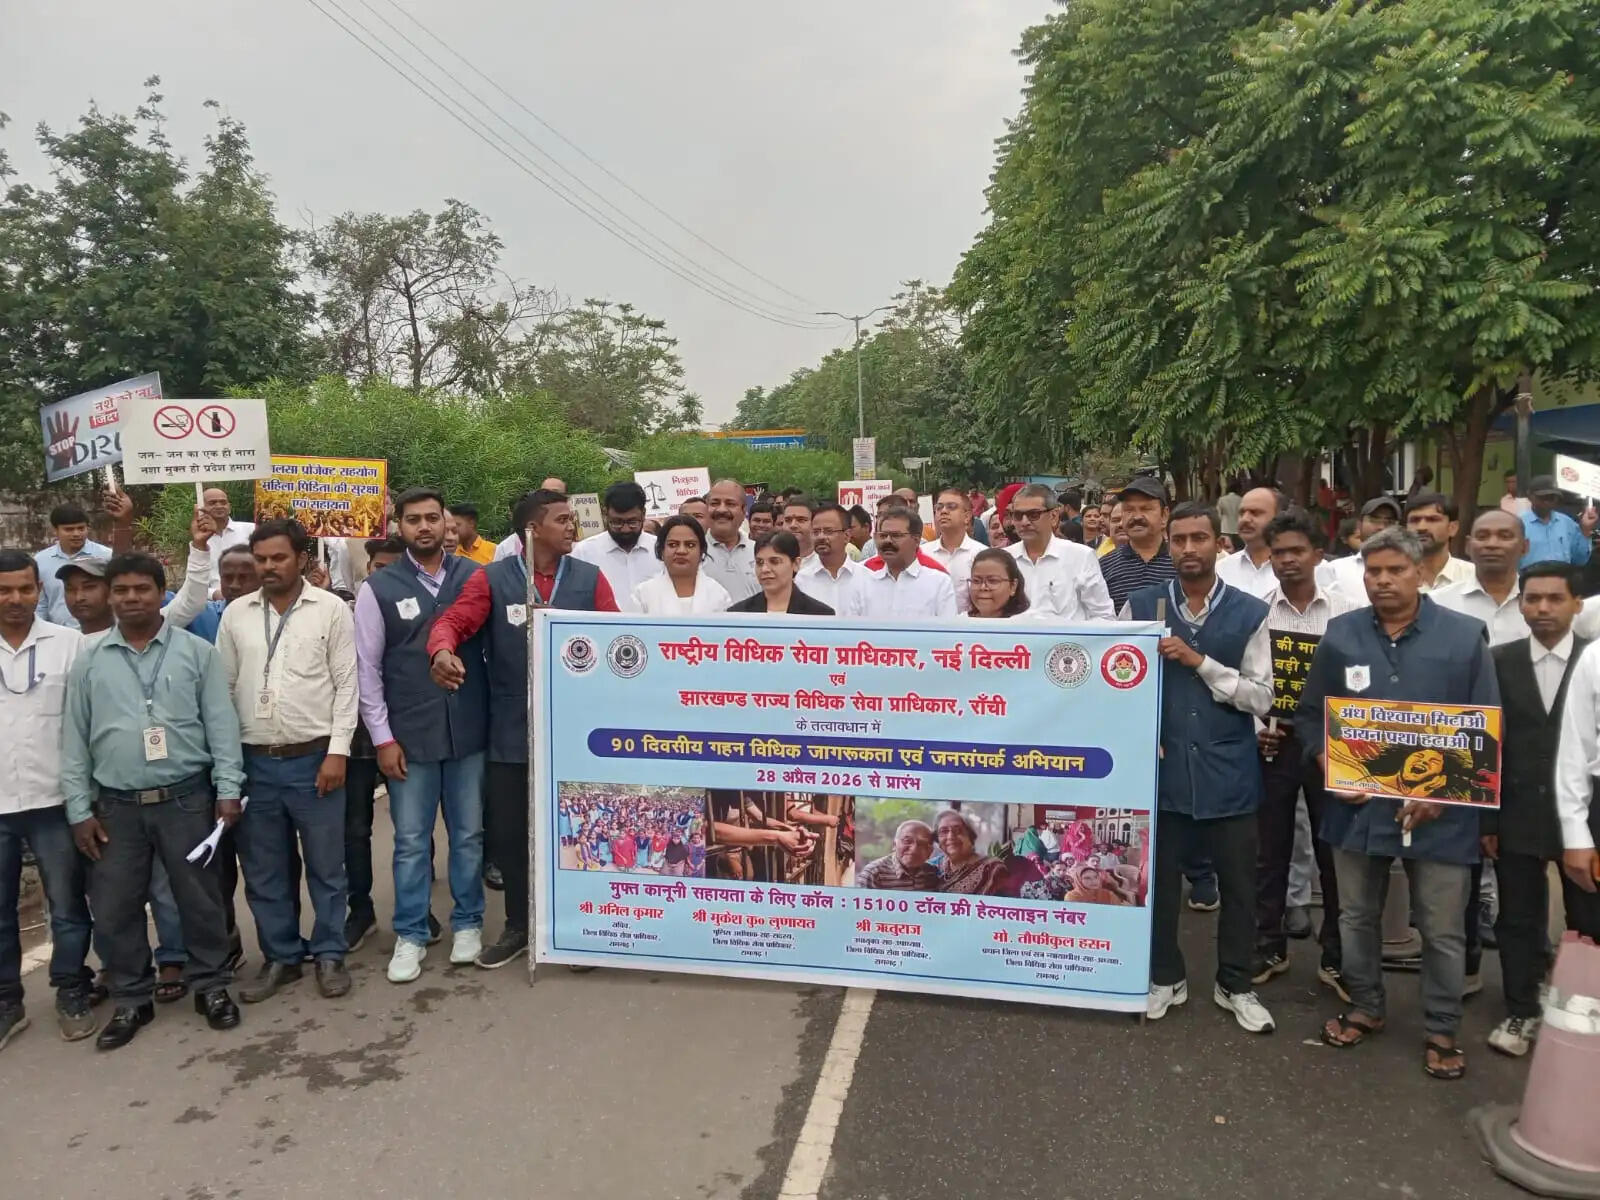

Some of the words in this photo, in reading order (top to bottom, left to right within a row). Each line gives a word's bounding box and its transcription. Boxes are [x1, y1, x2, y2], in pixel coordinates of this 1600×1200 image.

[49, 436, 75, 456] STOP
[166, 450, 182, 459] जन
[187, 450, 199, 458] का
[202, 450, 218, 459] एक
[235, 449, 256, 457] नारा
[141, 466, 161, 474] नशा
[164, 465, 186, 476] मुक्त
[203, 462, 226, 472] प्रदेश
[229, 463, 255, 472] हमारा
[272, 464, 298, 474] ालसा
[339, 466, 377, 477] सहयोग
[262, 479, 294, 491] महिला
[334, 482, 347, 493] की
[351, 485, 379, 496] सुरक्षा
[292, 497, 307, 509] एवं
[310, 500, 350, 510] सहायता
[659, 637, 718, 665] राष्ट्रीय
[725, 638, 784, 664] विधिक
[790, 640, 829, 665] सेवा
[835, 640, 925, 670] प्राधिकार,
[932, 643, 962, 671] नई
[969, 644, 1031, 670] दिल्ली
[1276, 636, 1294, 652] की
[1297, 642, 1319, 655] मा
[829, 671, 846, 686] एवं
[679, 690, 747, 708] झारखण्ड
[752, 691, 789, 709] राज्य
[796, 690, 844, 711] विधिक
[852, 691, 882, 711] सेवा
[888, 692, 963, 717] प्राधिकार,
[969, 692, 1007, 716] राँची
[795, 716, 807, 731] के
[810, 718, 868, 733] तत्वावधान
[870, 719, 881, 733] में
[1340, 704, 1366, 720] अंध
[1370, 706, 1427, 725] विश्वास
[1430, 710, 1487, 729] मिटाओ
[1341, 726, 1383, 742] डायन
[1384, 729, 1418, 745] प्रथा
[1419, 732, 1470, 749] हटाओ
[611, 737, 635, 753] 90
[642, 734, 703, 756] दिवसीय
[709, 739, 744, 757] गहन
[750, 737, 801, 760] विधिक
[807, 743, 893, 764] जागरूकता
[899, 746, 924, 767] एवं
[929, 747, 1006, 769] जनसंपर्क
[1012, 752, 1085, 773] अभियान
[756, 769, 776, 783] 28
[782, 766, 816, 785] अप्रैल
[821, 772, 862, 788] 2026
[868, 771, 881, 789] से
[886, 773, 922, 792] प्रारंभ
[579, 902, 593, 914] श्री
[598, 903, 629, 917] अनिल
[633, 905, 664, 920] कुमार
[609, 881, 639, 900] मुफ्त
[643, 882, 688, 902] कानूनी
[692, 886, 745, 903] सहायता
[750, 886, 765, 904] के
[768, 887, 796, 909] लिए
[801, 890, 834, 910] कॉल
[852, 896, 908, 914] 15100
[914, 897, 946, 915] टॉल
[949, 899, 971, 918] फ्री
[976, 900, 1047, 923] हेल्पलाइन
[1053, 908, 1087, 926] नंबर
[692, 909, 706, 923] श्री
[710, 911, 743, 926] मुकेश
[769, 914, 816, 930] लुणायत
[856, 919, 871, 932] श्री
[875, 922, 922, 936] ऋतुराज
[992, 929, 1013, 944] मो.
[1017, 930, 1075, 950] तौफीकुल
[1078, 936, 1111, 952] हसन
